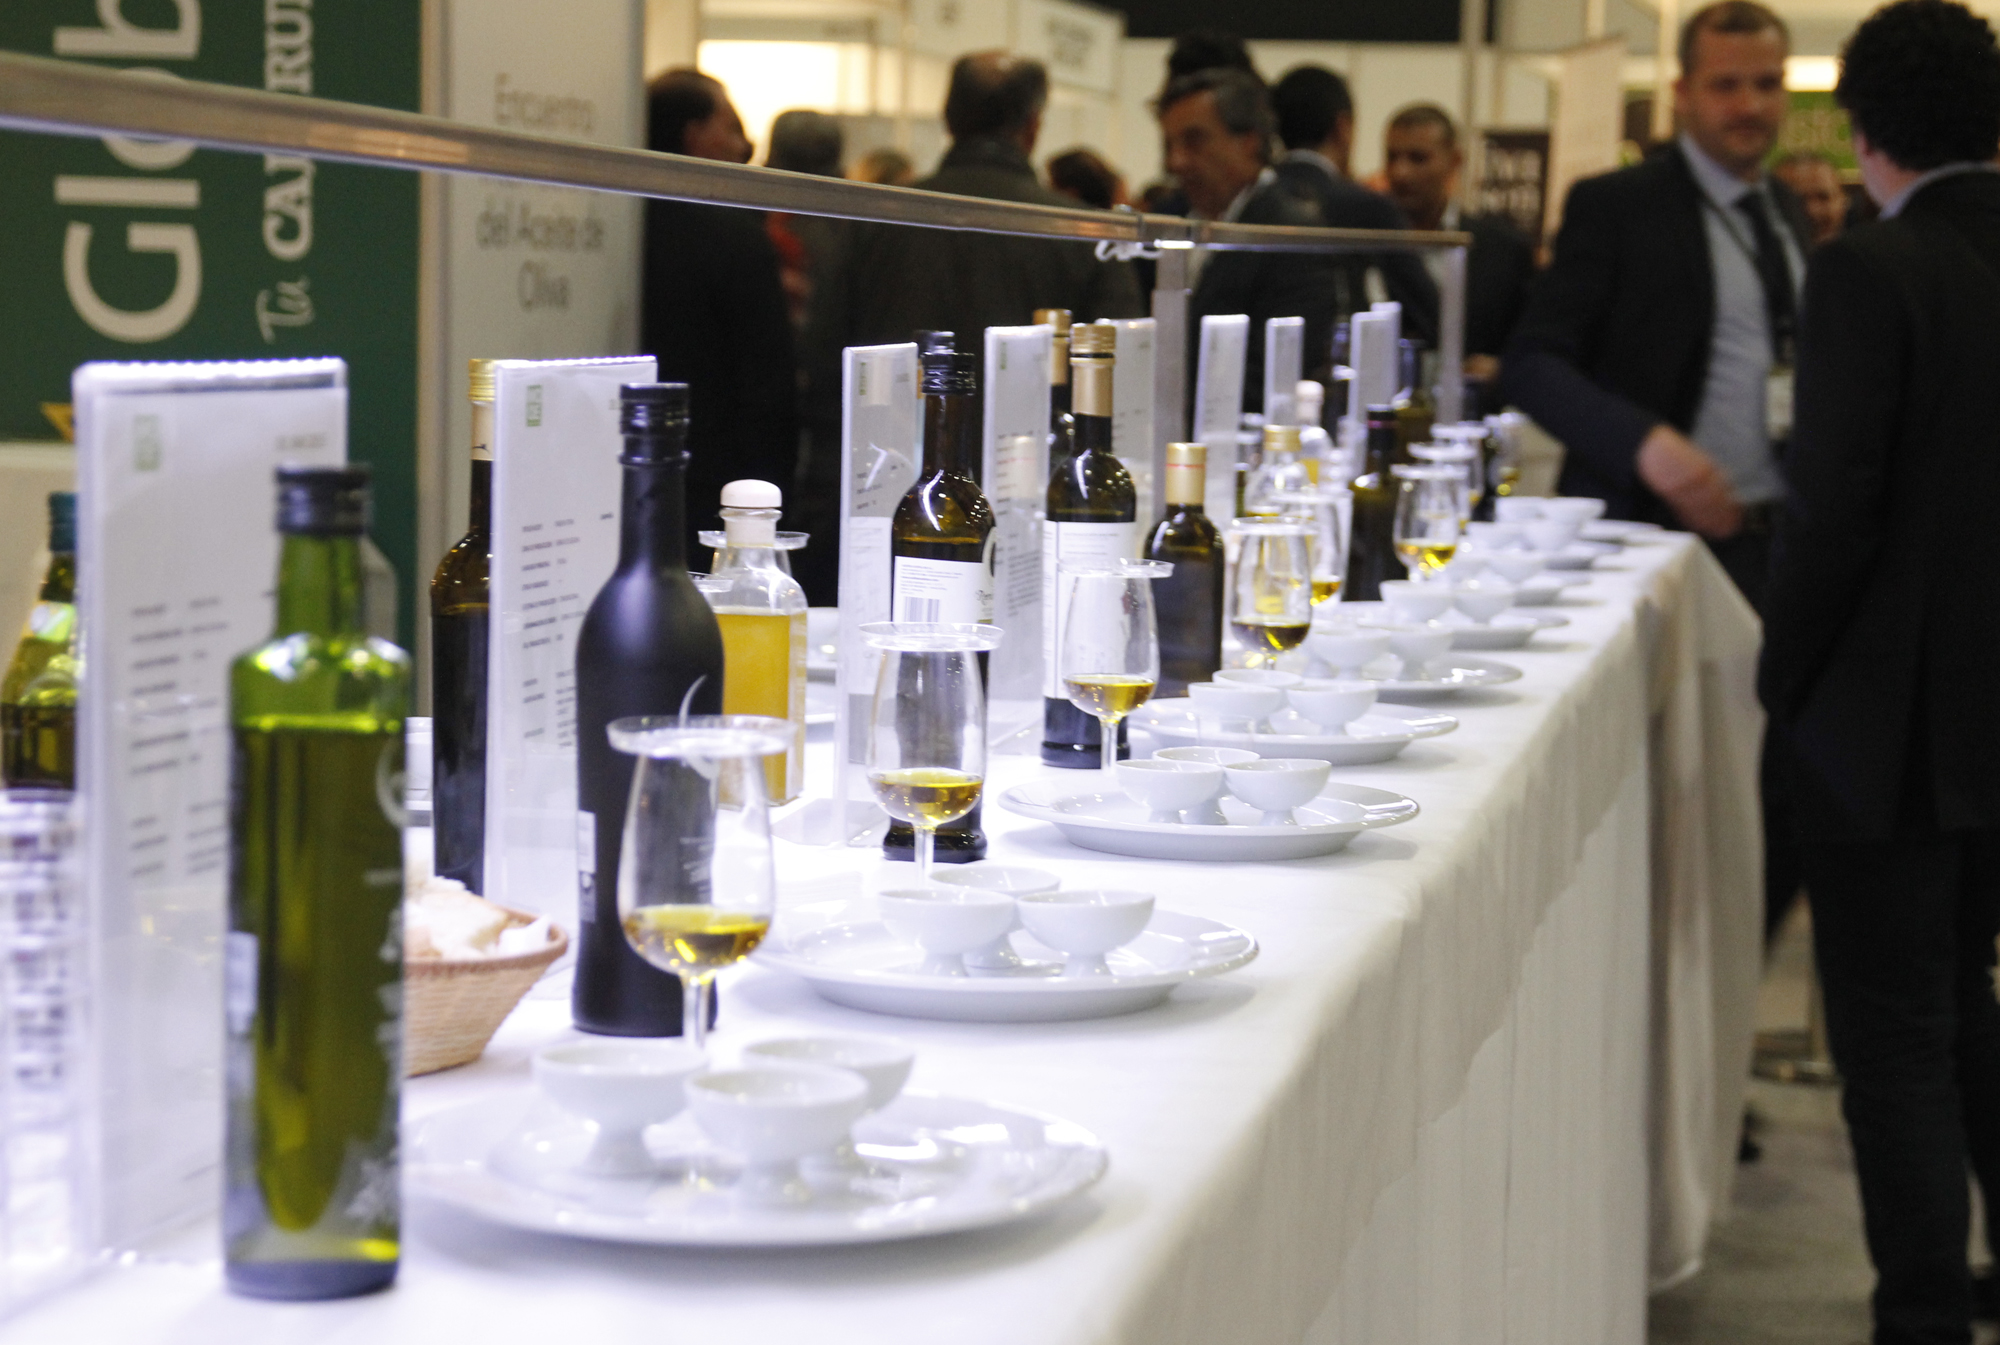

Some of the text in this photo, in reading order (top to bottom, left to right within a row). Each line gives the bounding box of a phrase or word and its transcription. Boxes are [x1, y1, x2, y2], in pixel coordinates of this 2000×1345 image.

[256, 0, 317, 344] Tu CAJ RU
